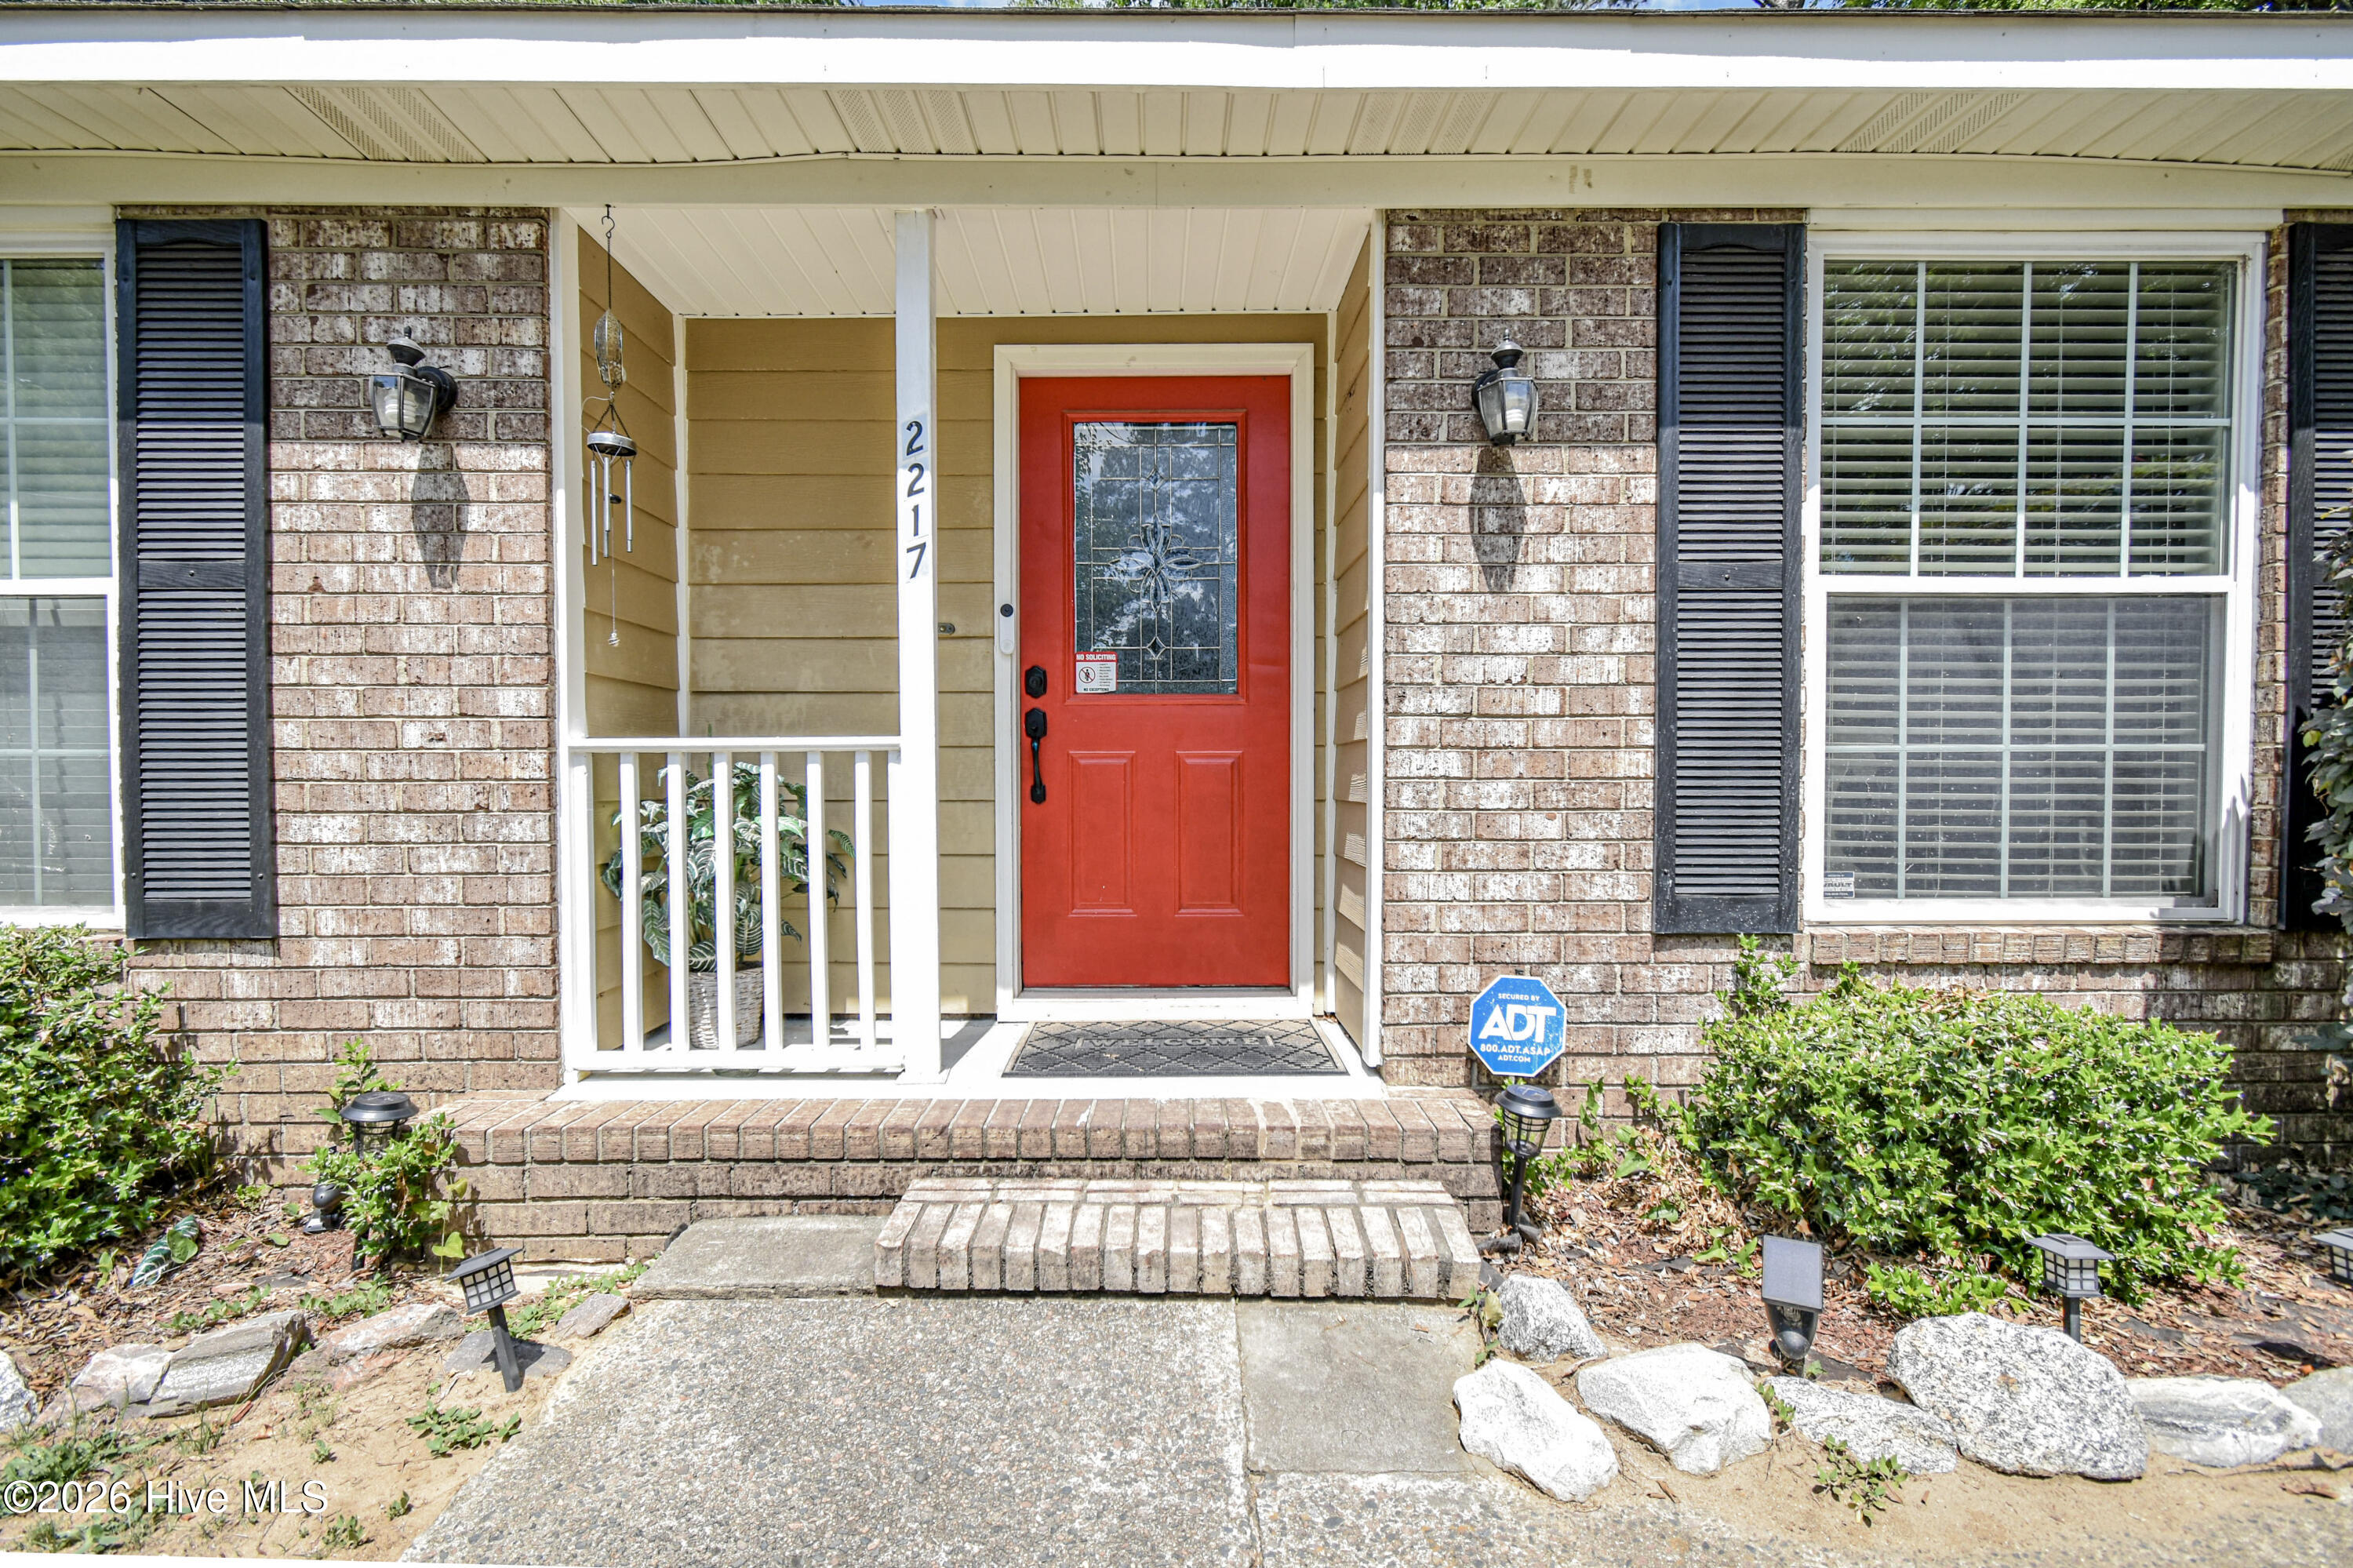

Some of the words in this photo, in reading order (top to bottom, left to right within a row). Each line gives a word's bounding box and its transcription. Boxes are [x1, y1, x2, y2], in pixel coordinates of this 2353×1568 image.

[906, 420, 927, 579] 2217
[1478, 1003, 1557, 1043] ADT
[1089, 1036, 1261, 1048] WELCOME
[1480, 1043, 1551, 1057] 800.ADT.ASAP
[1497, 1054, 1531, 1063] ADT.COM
